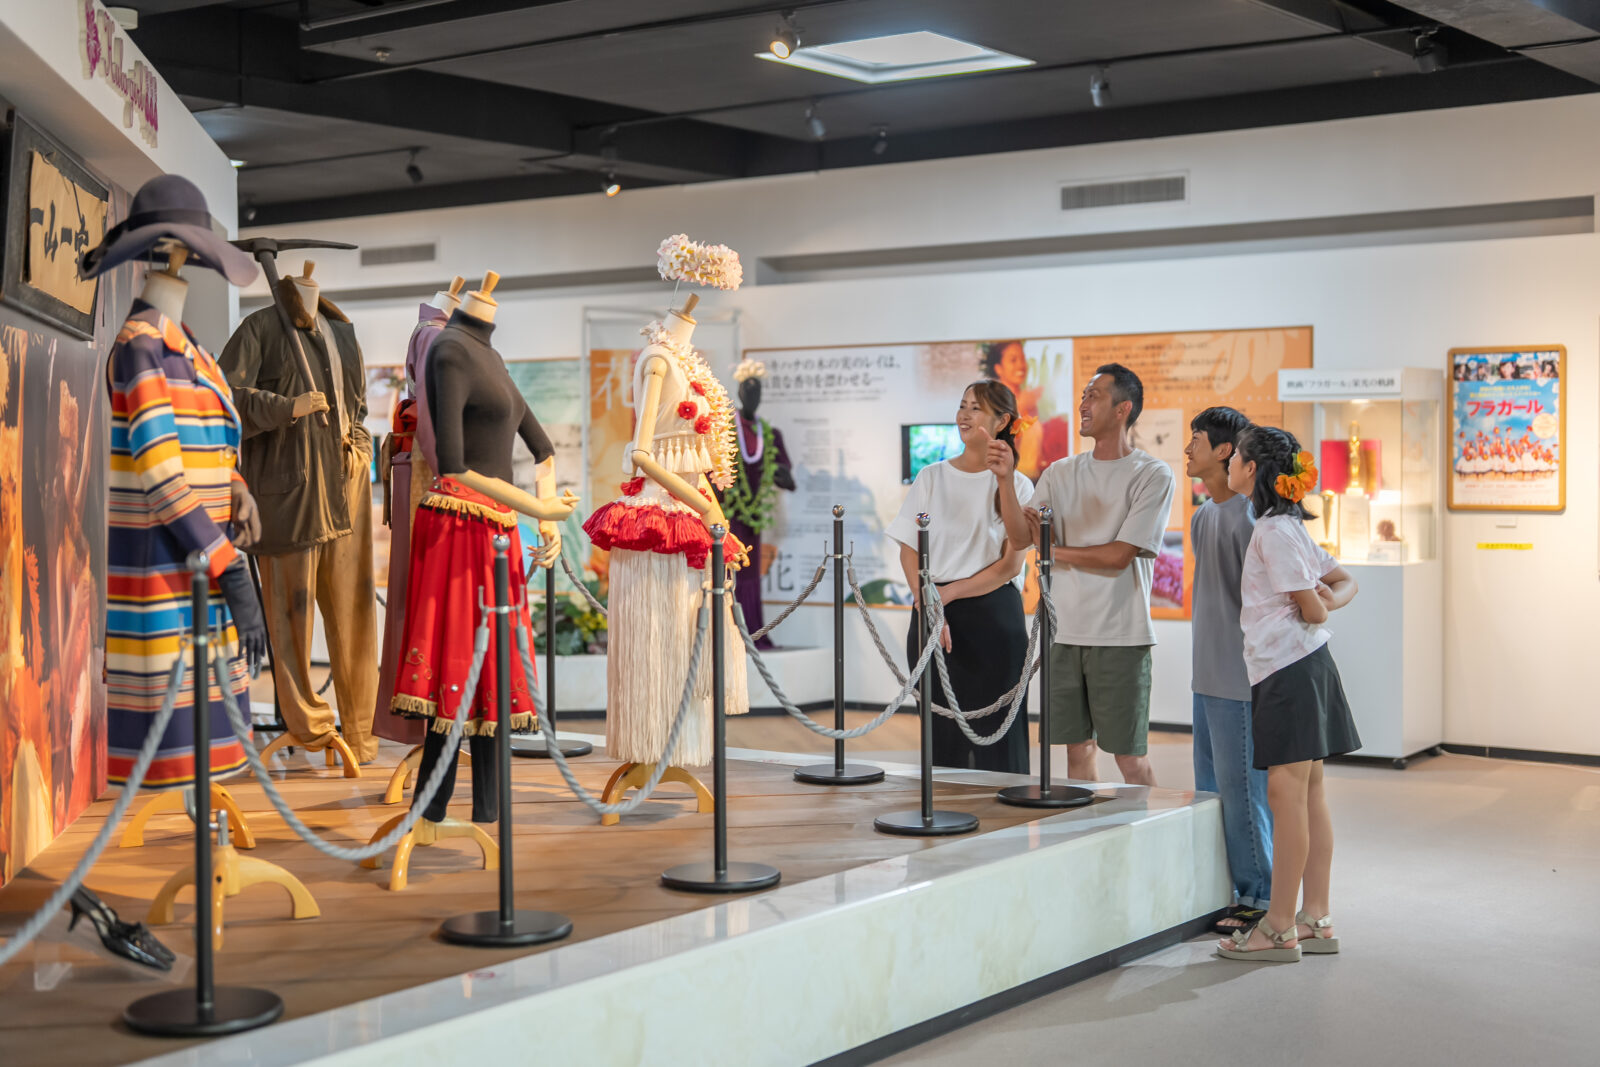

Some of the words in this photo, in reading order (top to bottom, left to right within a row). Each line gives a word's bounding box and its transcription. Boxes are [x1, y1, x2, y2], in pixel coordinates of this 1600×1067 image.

[1467, 399, 1544, 416] フラガール
